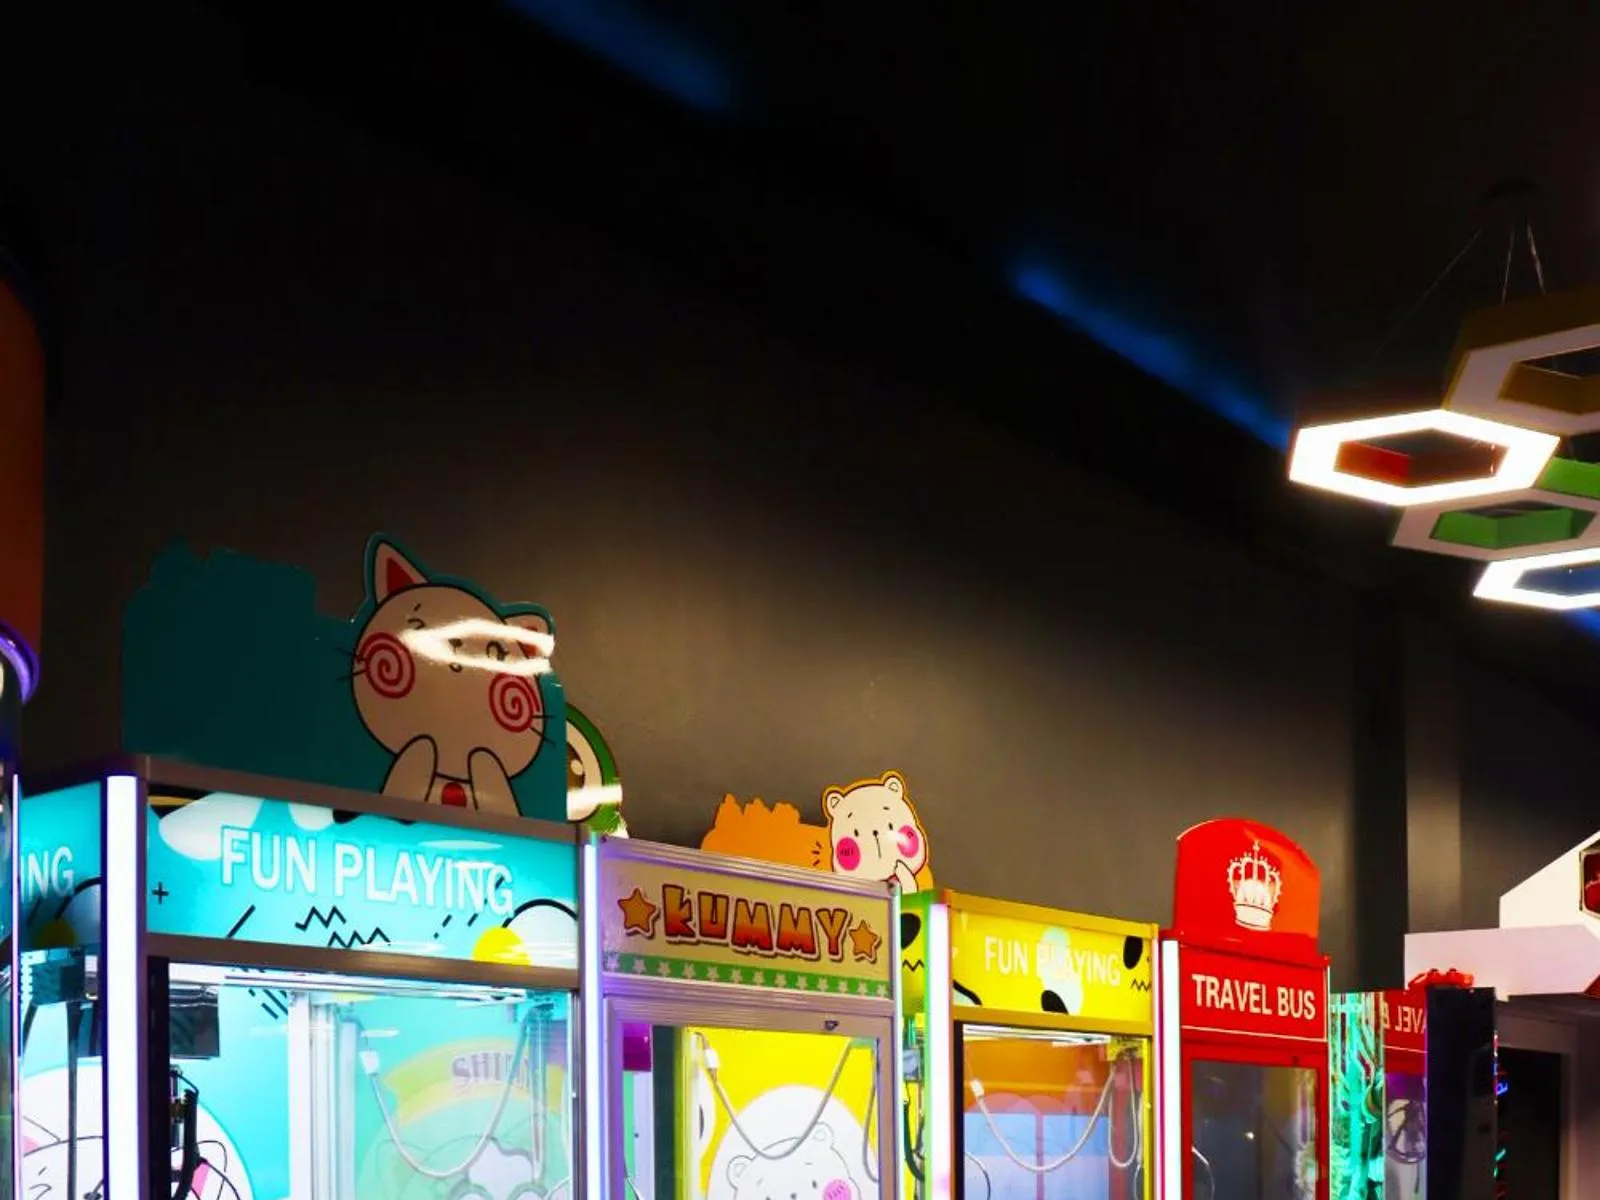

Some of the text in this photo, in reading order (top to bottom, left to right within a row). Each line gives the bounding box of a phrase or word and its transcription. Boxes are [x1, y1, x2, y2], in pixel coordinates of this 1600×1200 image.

[220, 825, 515, 915] FUN PLAYING
[661, 882, 850, 958] KUMMY
[984, 934, 1122, 988] FUN PLAYING
[1191, 973, 1317, 1021] TRAVEL BUS
